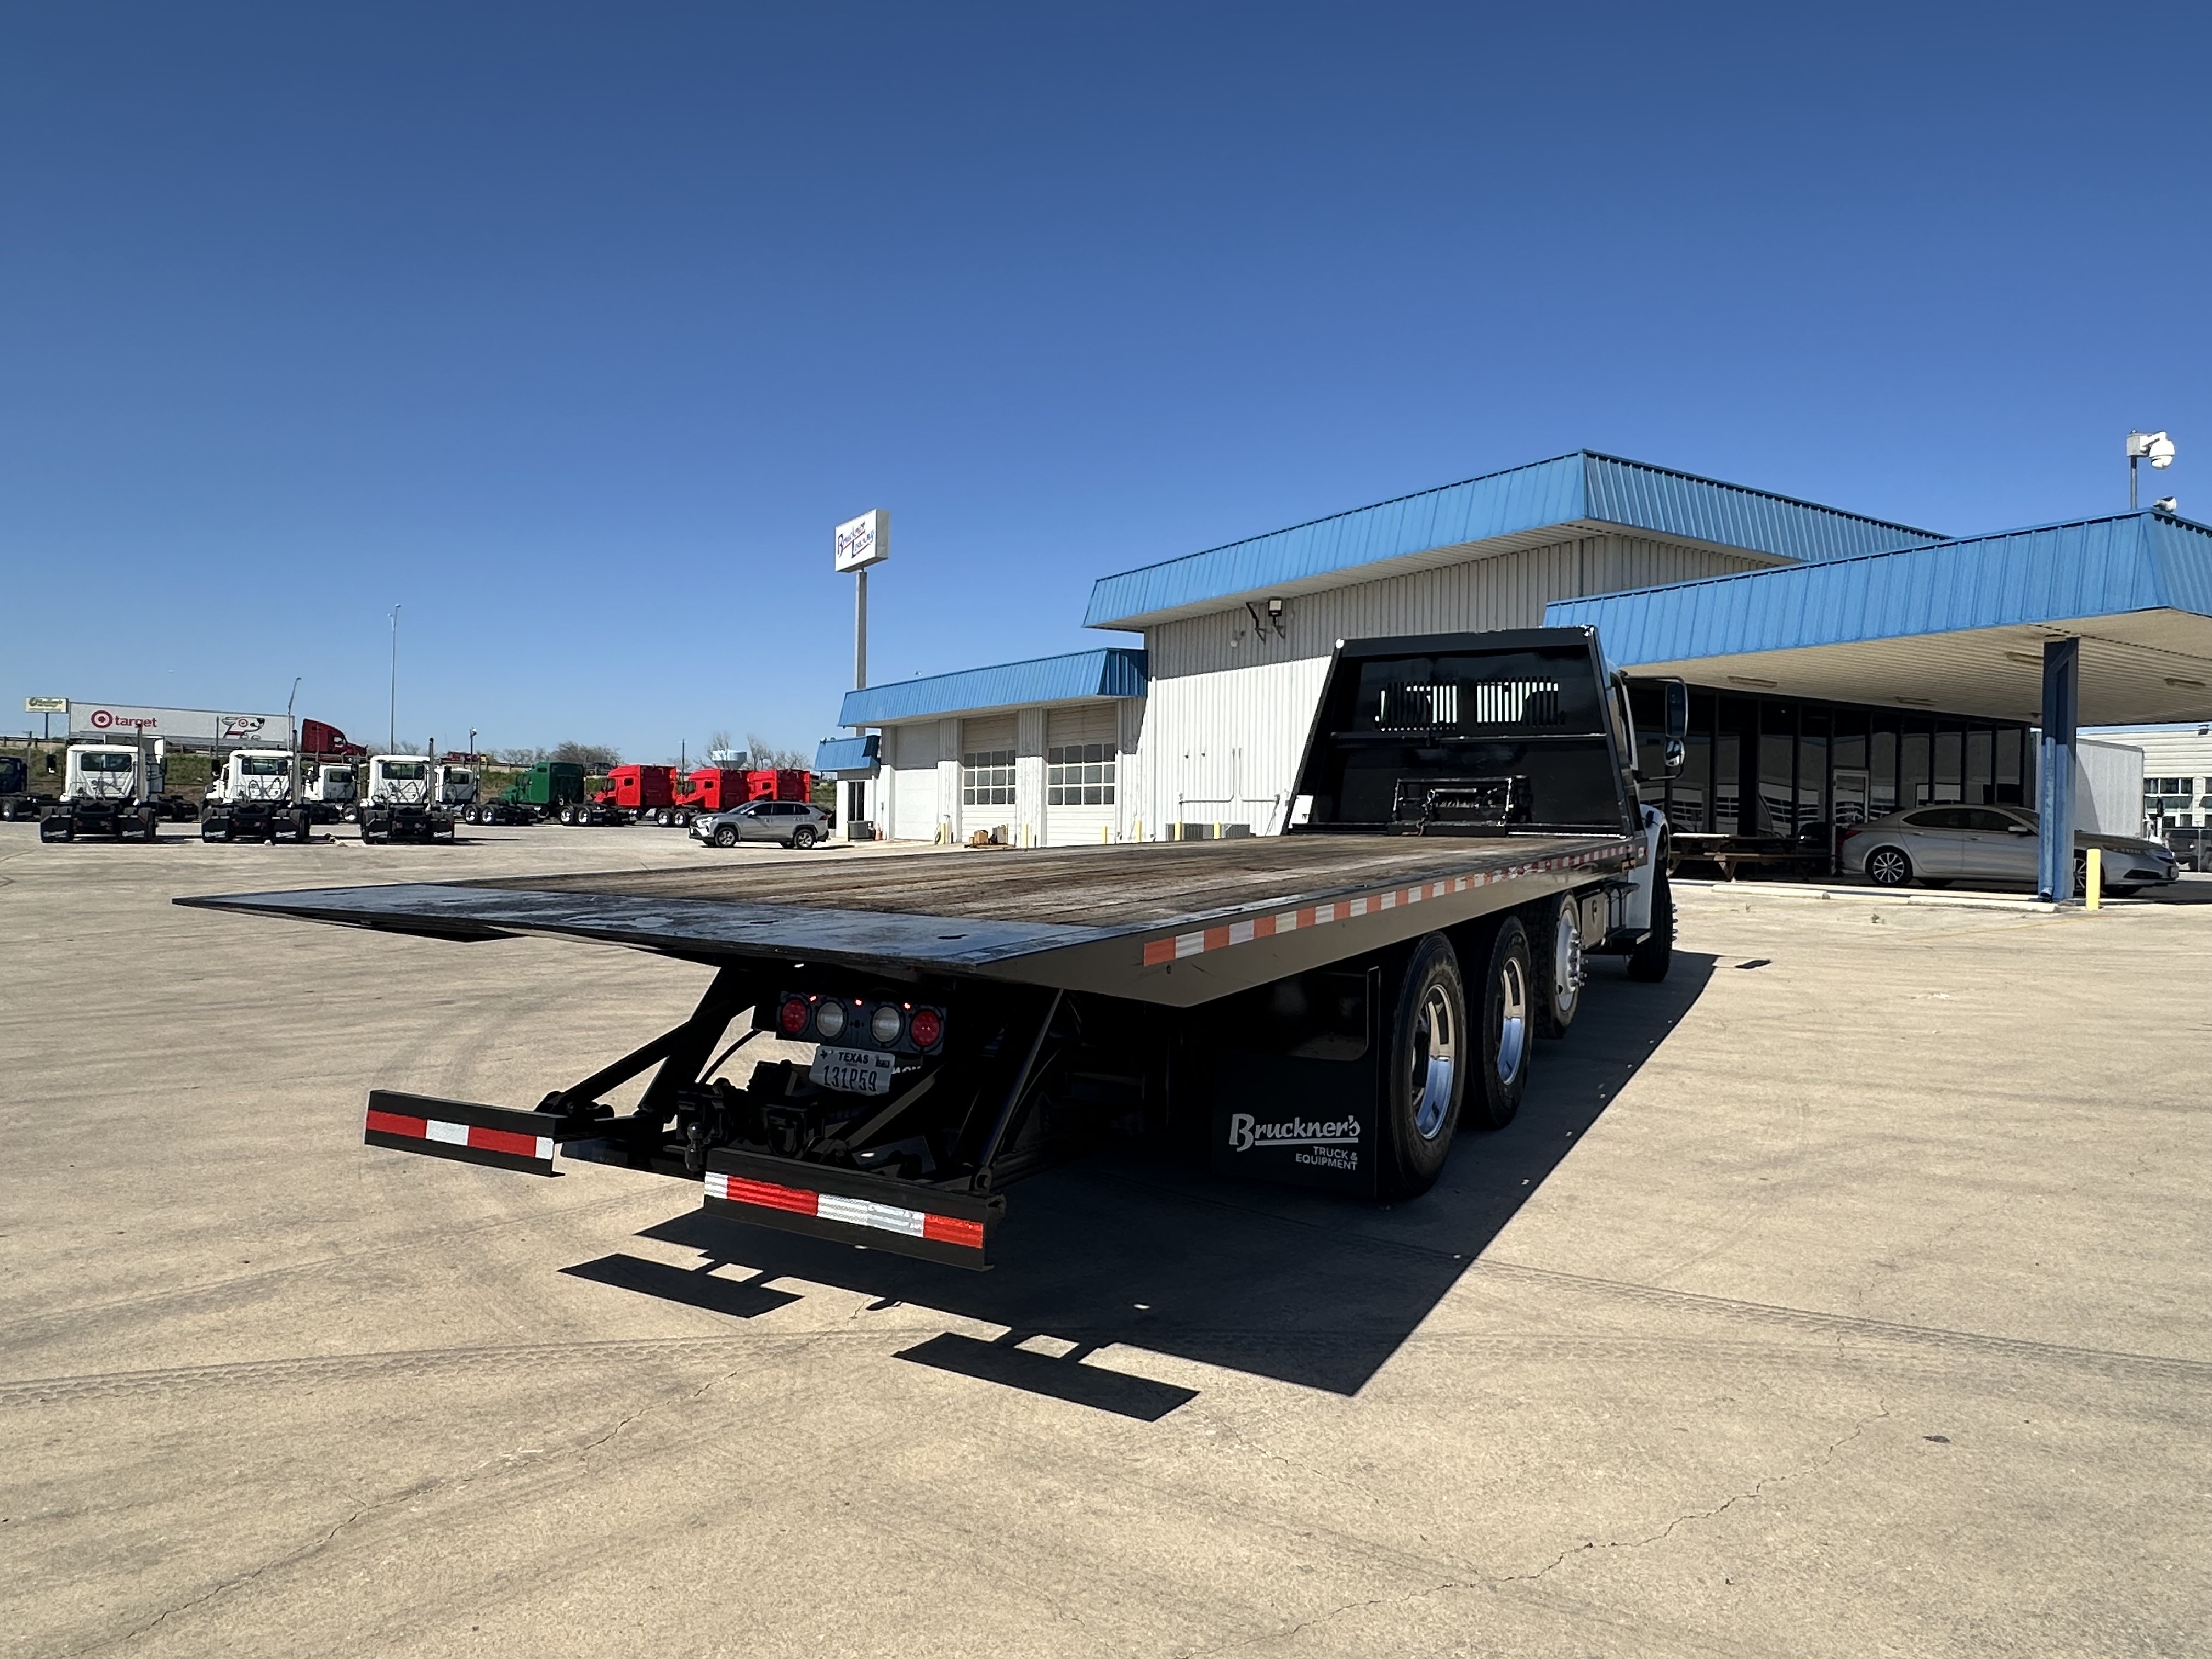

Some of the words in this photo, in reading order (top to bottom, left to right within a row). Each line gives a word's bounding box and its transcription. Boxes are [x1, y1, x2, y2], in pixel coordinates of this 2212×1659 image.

[115, 715, 157, 728] target
[838, 1052, 869, 1064] TEXAS
[823, 1065, 877, 1092] 131P59
[1229, 1113, 1361, 1152] Bruckner's
[1295, 1153, 1358, 1170] EQUIPMENT
[1313, 1146, 1348, 1160] TRUCK
[1350, 1152, 1358, 1161] &
